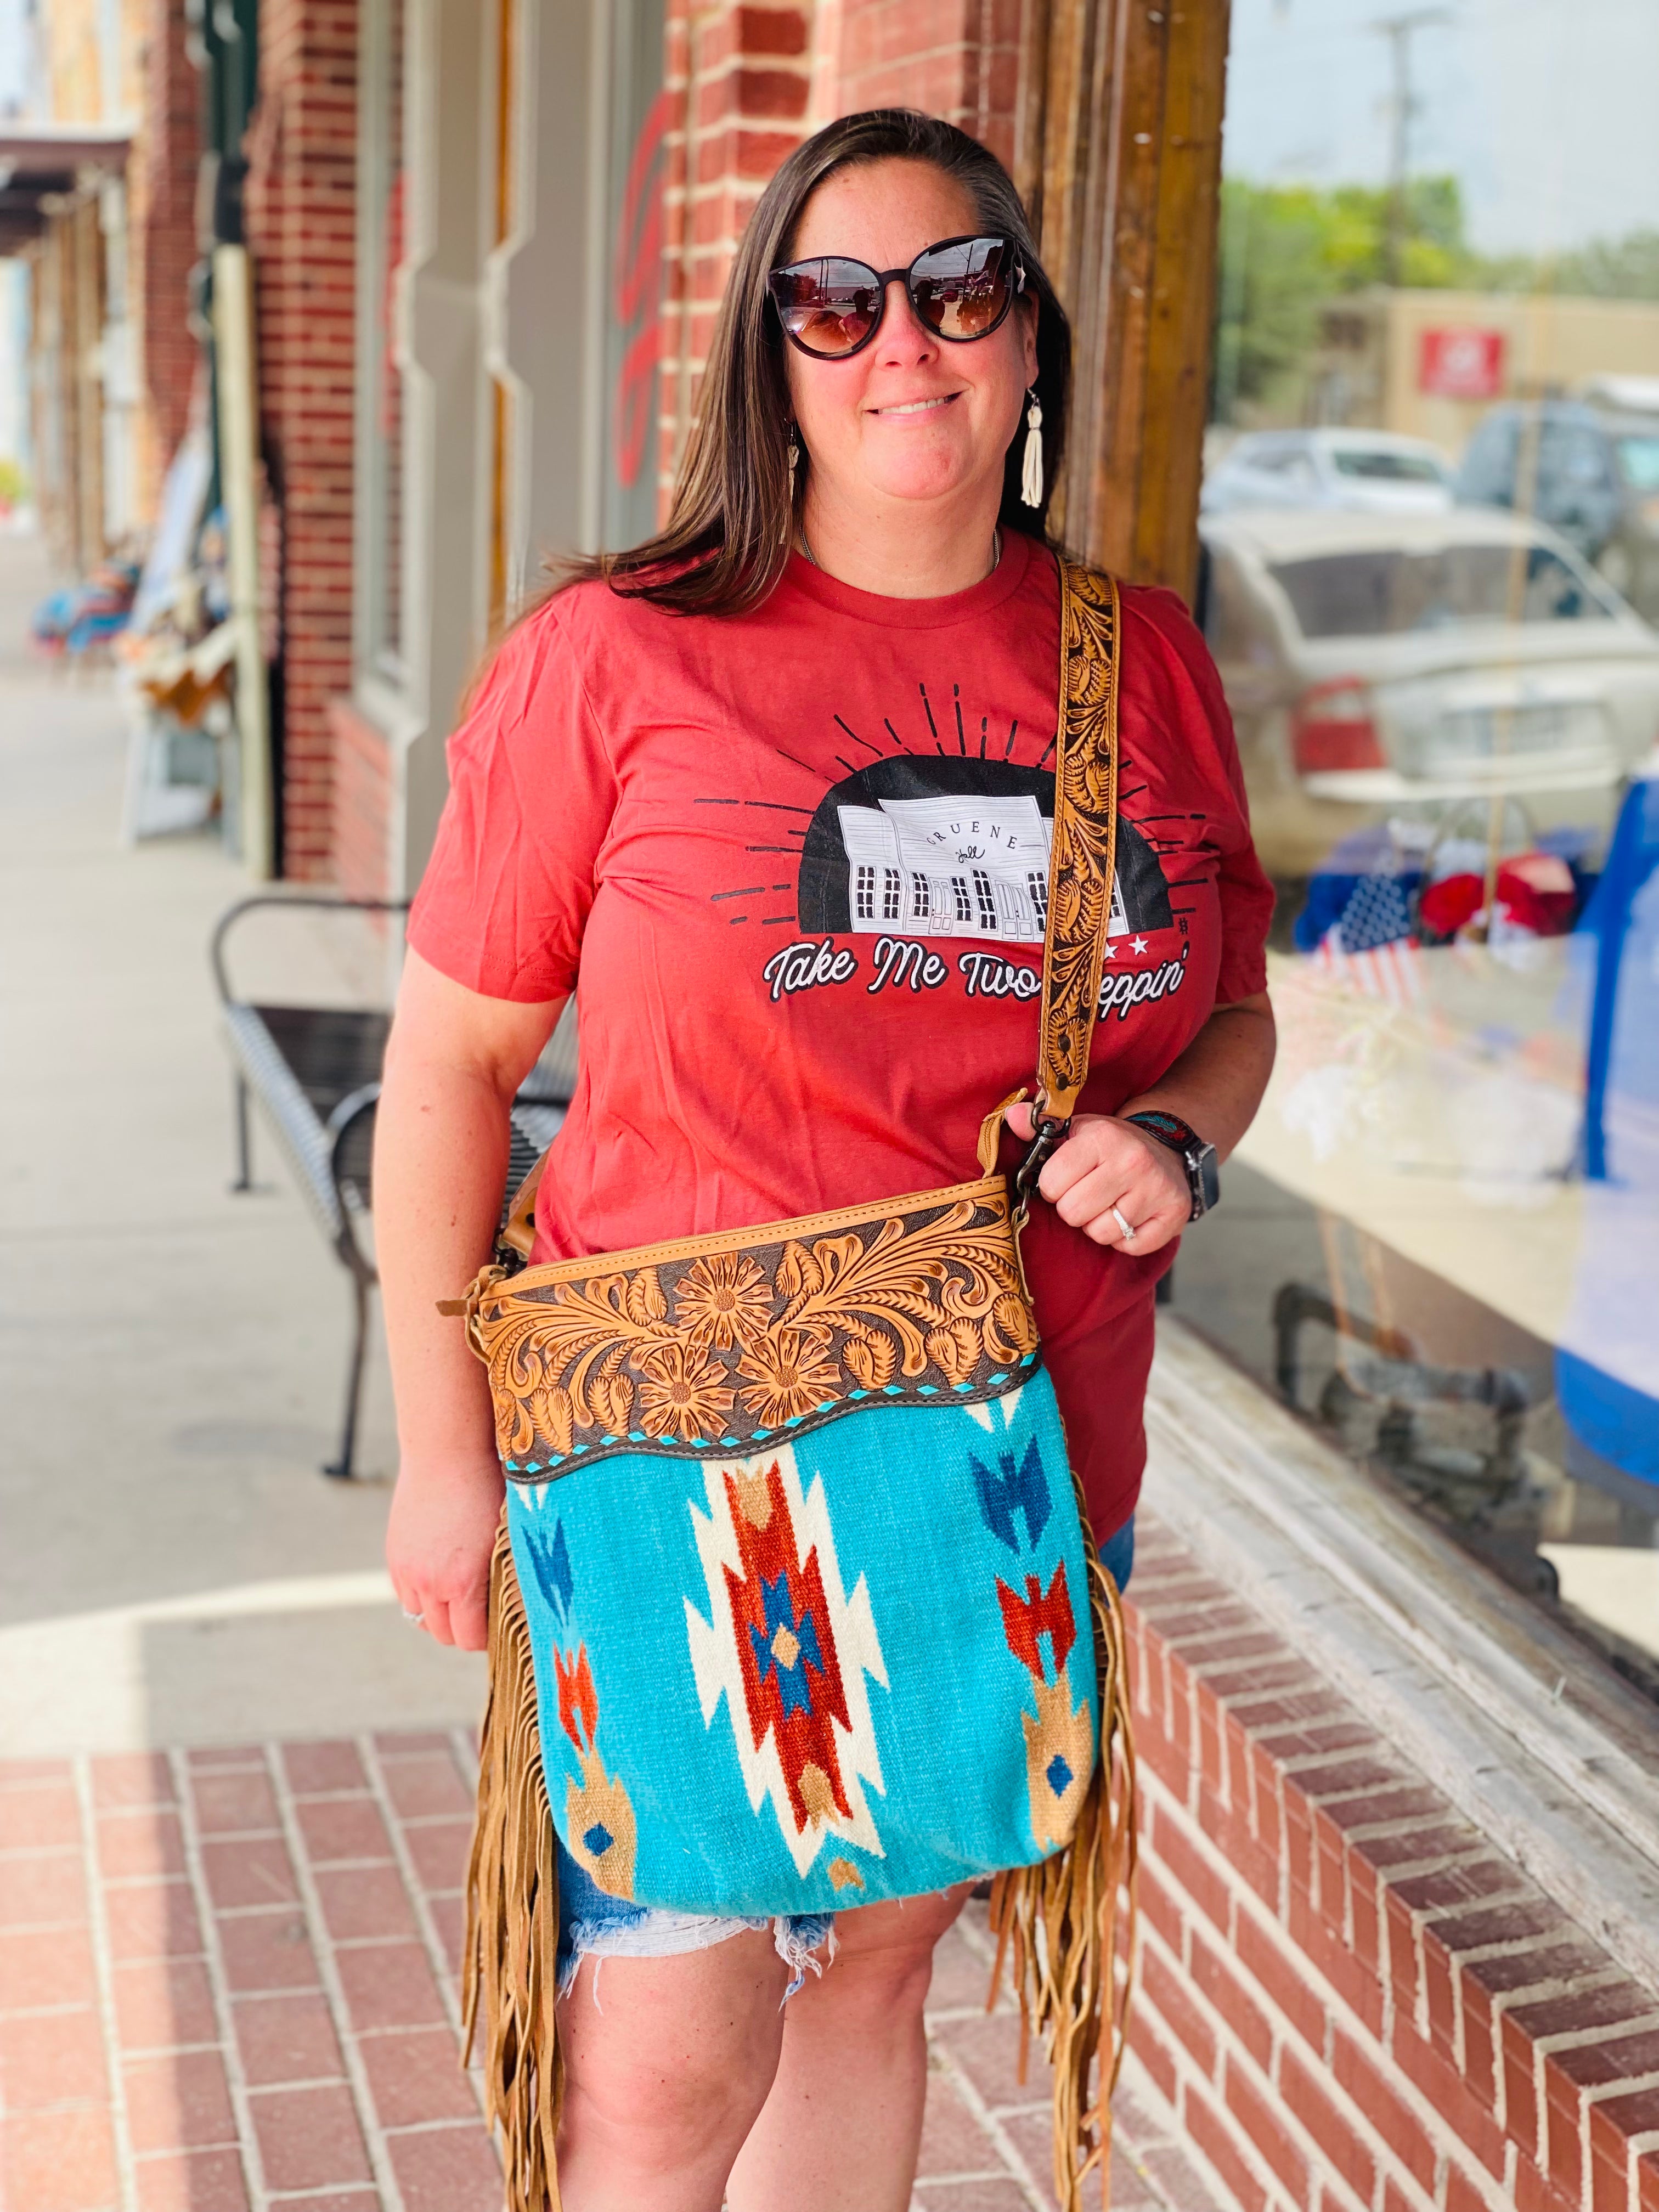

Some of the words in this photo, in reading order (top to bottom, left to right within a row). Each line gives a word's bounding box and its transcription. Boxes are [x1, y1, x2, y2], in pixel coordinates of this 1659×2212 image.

[927, 821, 1017, 849] GRUENE
[763, 937, 857, 1001] Take
[868, 936, 948, 993] Me
[958, 952, 1042, 1001] Two
[1097, 943, 1189, 1020] eppin'
